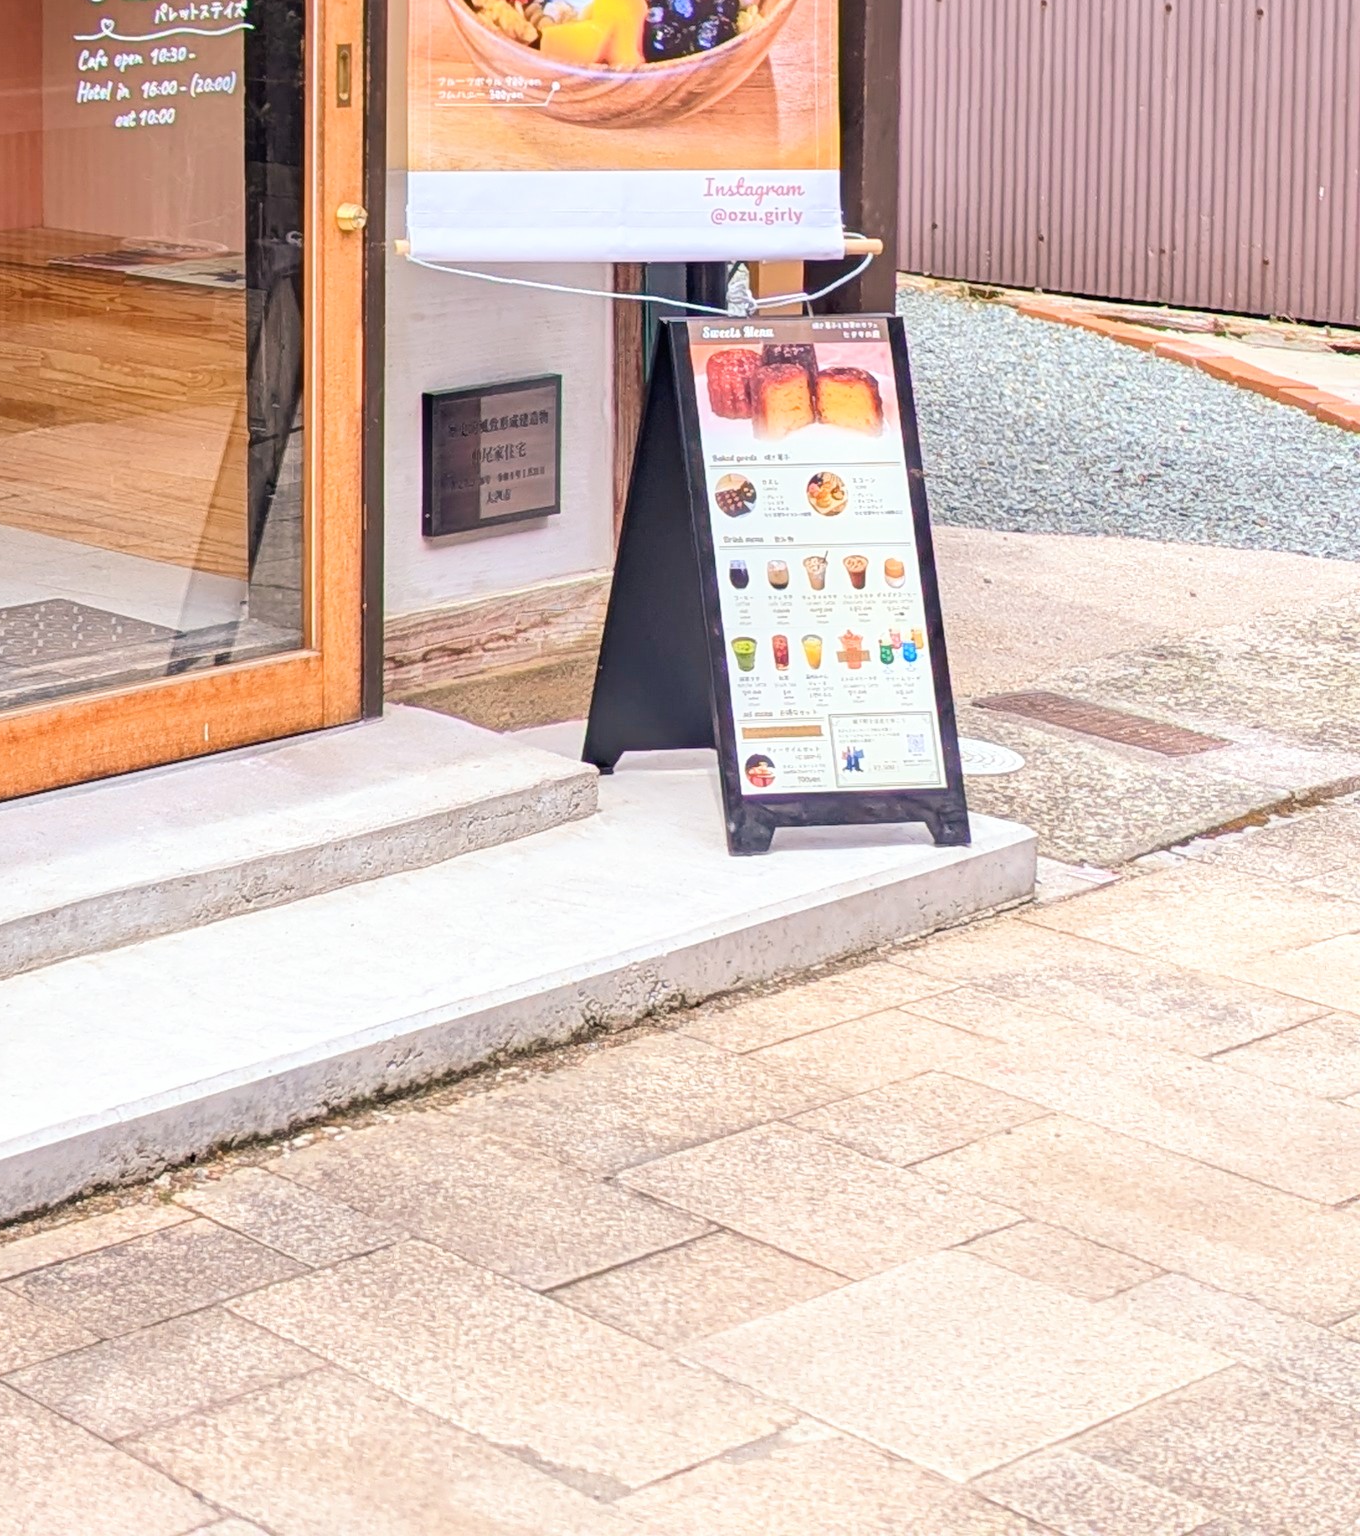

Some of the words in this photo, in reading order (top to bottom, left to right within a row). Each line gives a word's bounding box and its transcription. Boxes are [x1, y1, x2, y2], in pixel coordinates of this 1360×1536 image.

[155, 0, 249, 24] パレットステイズ
[78, 49, 108, 71] Cafe
[114, 52, 143, 72] open
[76, 81, 112, 103] Hotel
[116, 82, 130, 100] in
[115, 110, 137, 128] out
[139, 107, 176, 126] 10:00
[703, 177, 805, 206] Instagram
[711, 207, 803, 225] @ozu.girly
[702, 326, 742, 339] Sweets
[743, 326, 775, 338] Menu
